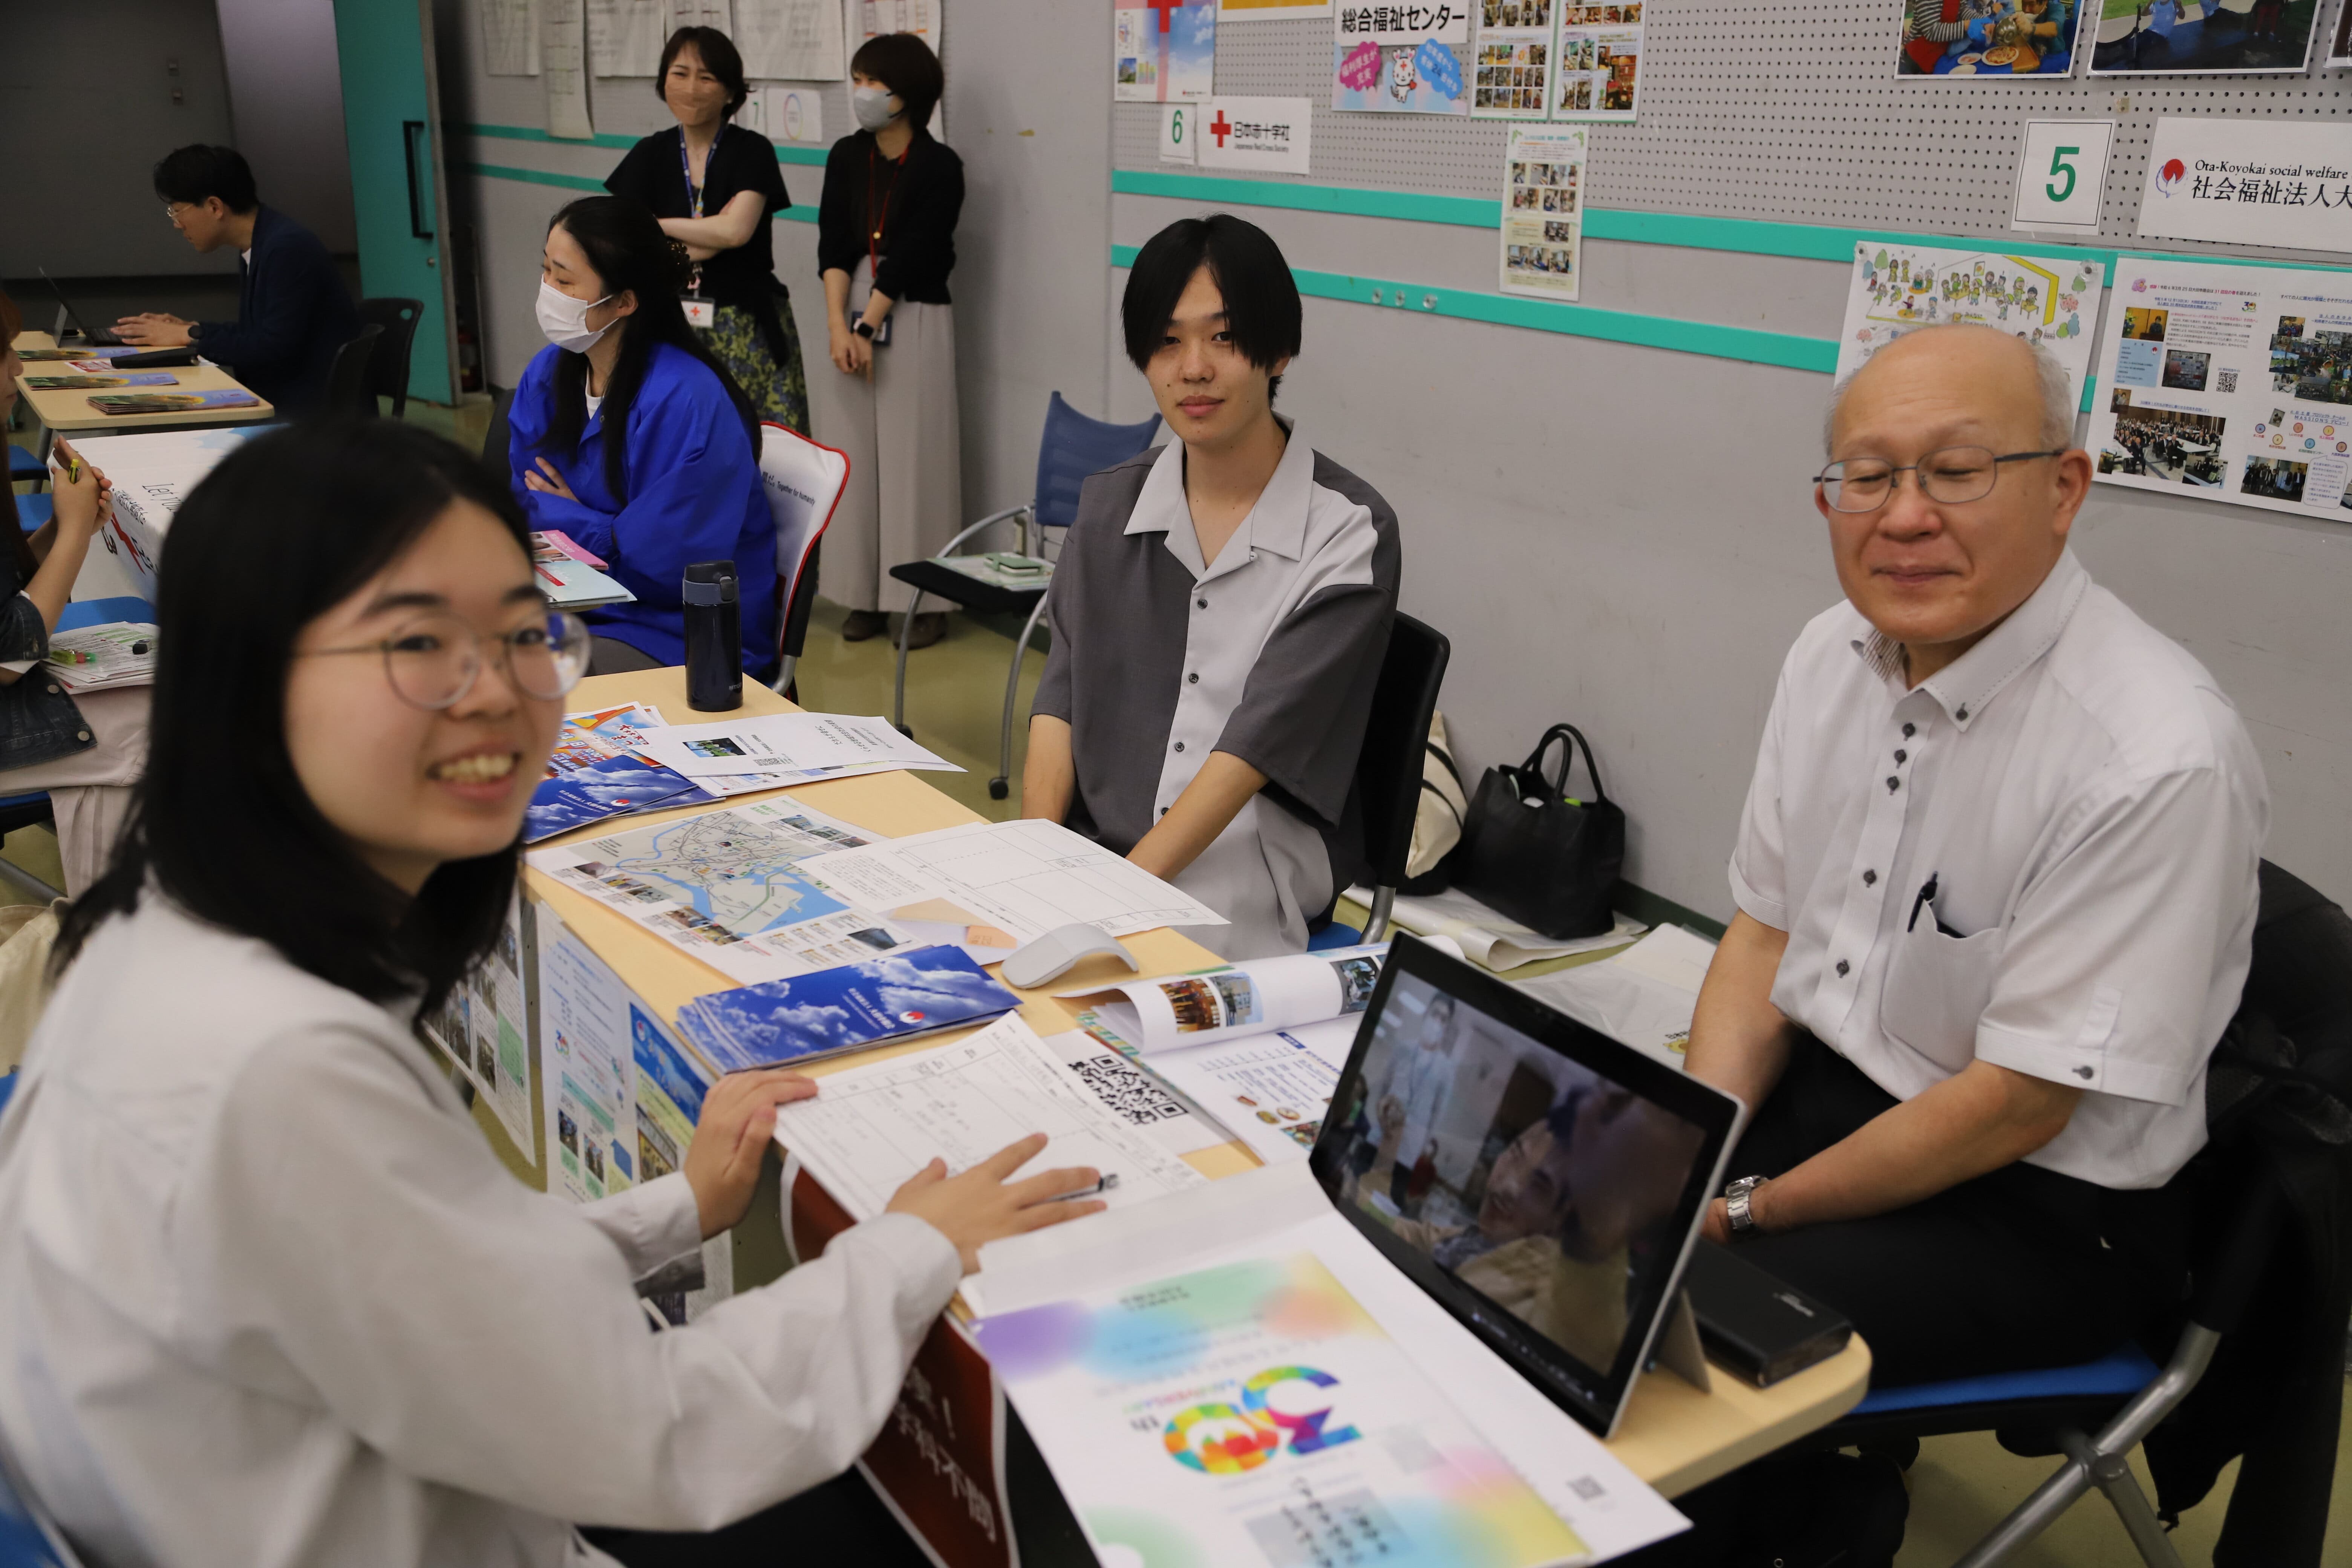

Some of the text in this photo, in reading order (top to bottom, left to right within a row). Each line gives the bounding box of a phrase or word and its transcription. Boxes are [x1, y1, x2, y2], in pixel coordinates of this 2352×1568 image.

[1341, 5, 1465, 34] 総合福祉センター
[1172, 110, 1183, 144] 6
[2046, 147, 2080, 202] 5
[2195, 159, 2348, 179] Ota-Koyokai social welfare
[2191, 174, 2352, 210] 社会福祉法人大
[2294, 415, 2329, 424] MASSION'S
[777, 480, 793, 494] Together
[799, 491, 815, 507] humanity
